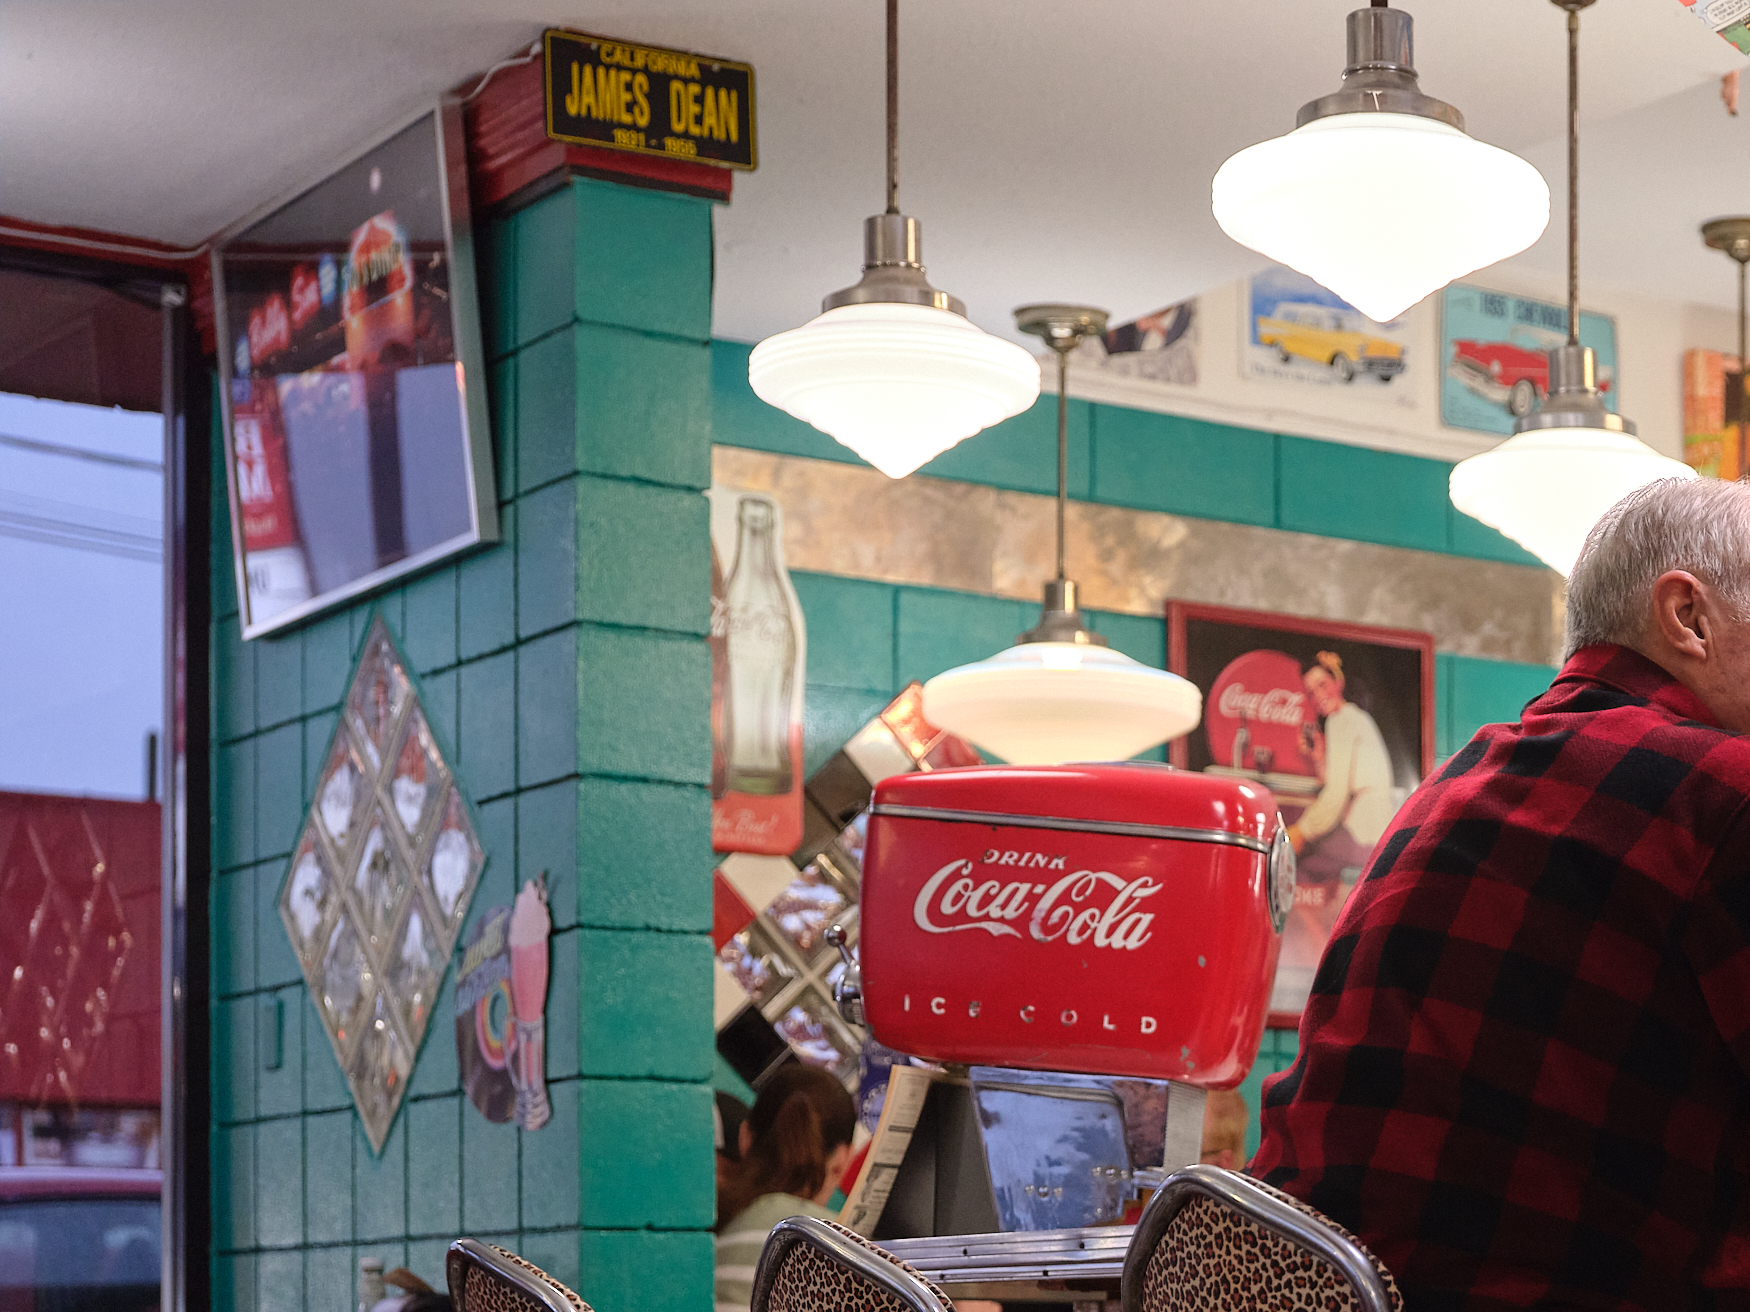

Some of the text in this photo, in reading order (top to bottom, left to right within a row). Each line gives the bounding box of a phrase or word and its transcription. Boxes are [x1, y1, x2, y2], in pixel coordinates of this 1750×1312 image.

[600, 42, 700, 79] CALIFORNIA
[565, 60, 739, 144] JAMES DEAN
[1219, 682, 1304, 727] Coca-Cola
[979, 848, 1069, 870] DRINK
[913, 858, 1164, 951] Coca-Cola
[904, 994, 1158, 1035] ICE COLD
